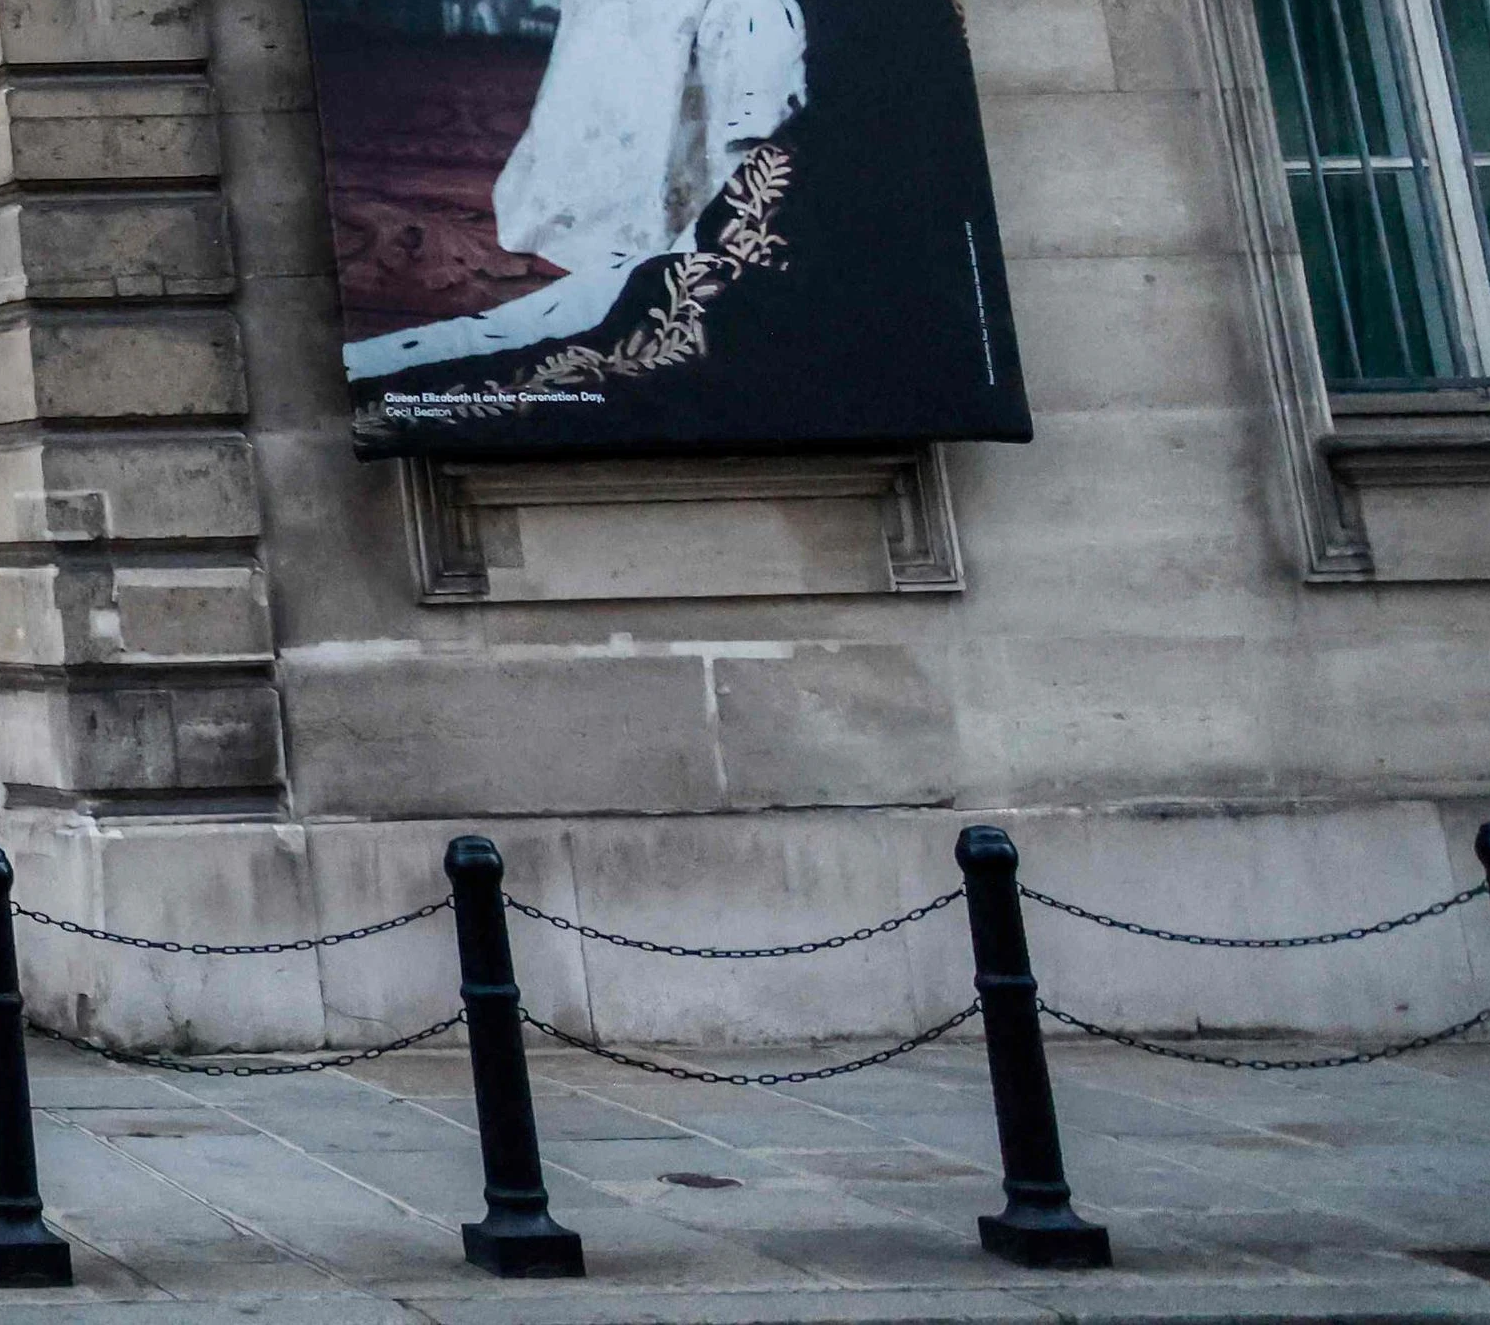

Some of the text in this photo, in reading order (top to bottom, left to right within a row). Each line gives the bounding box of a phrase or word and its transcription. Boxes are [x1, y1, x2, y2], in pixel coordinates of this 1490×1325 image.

[384, 391, 605, 404] Queen Elizabeth II on her Coronation Day,
[385, 406, 452, 417] Cecil Beaton
